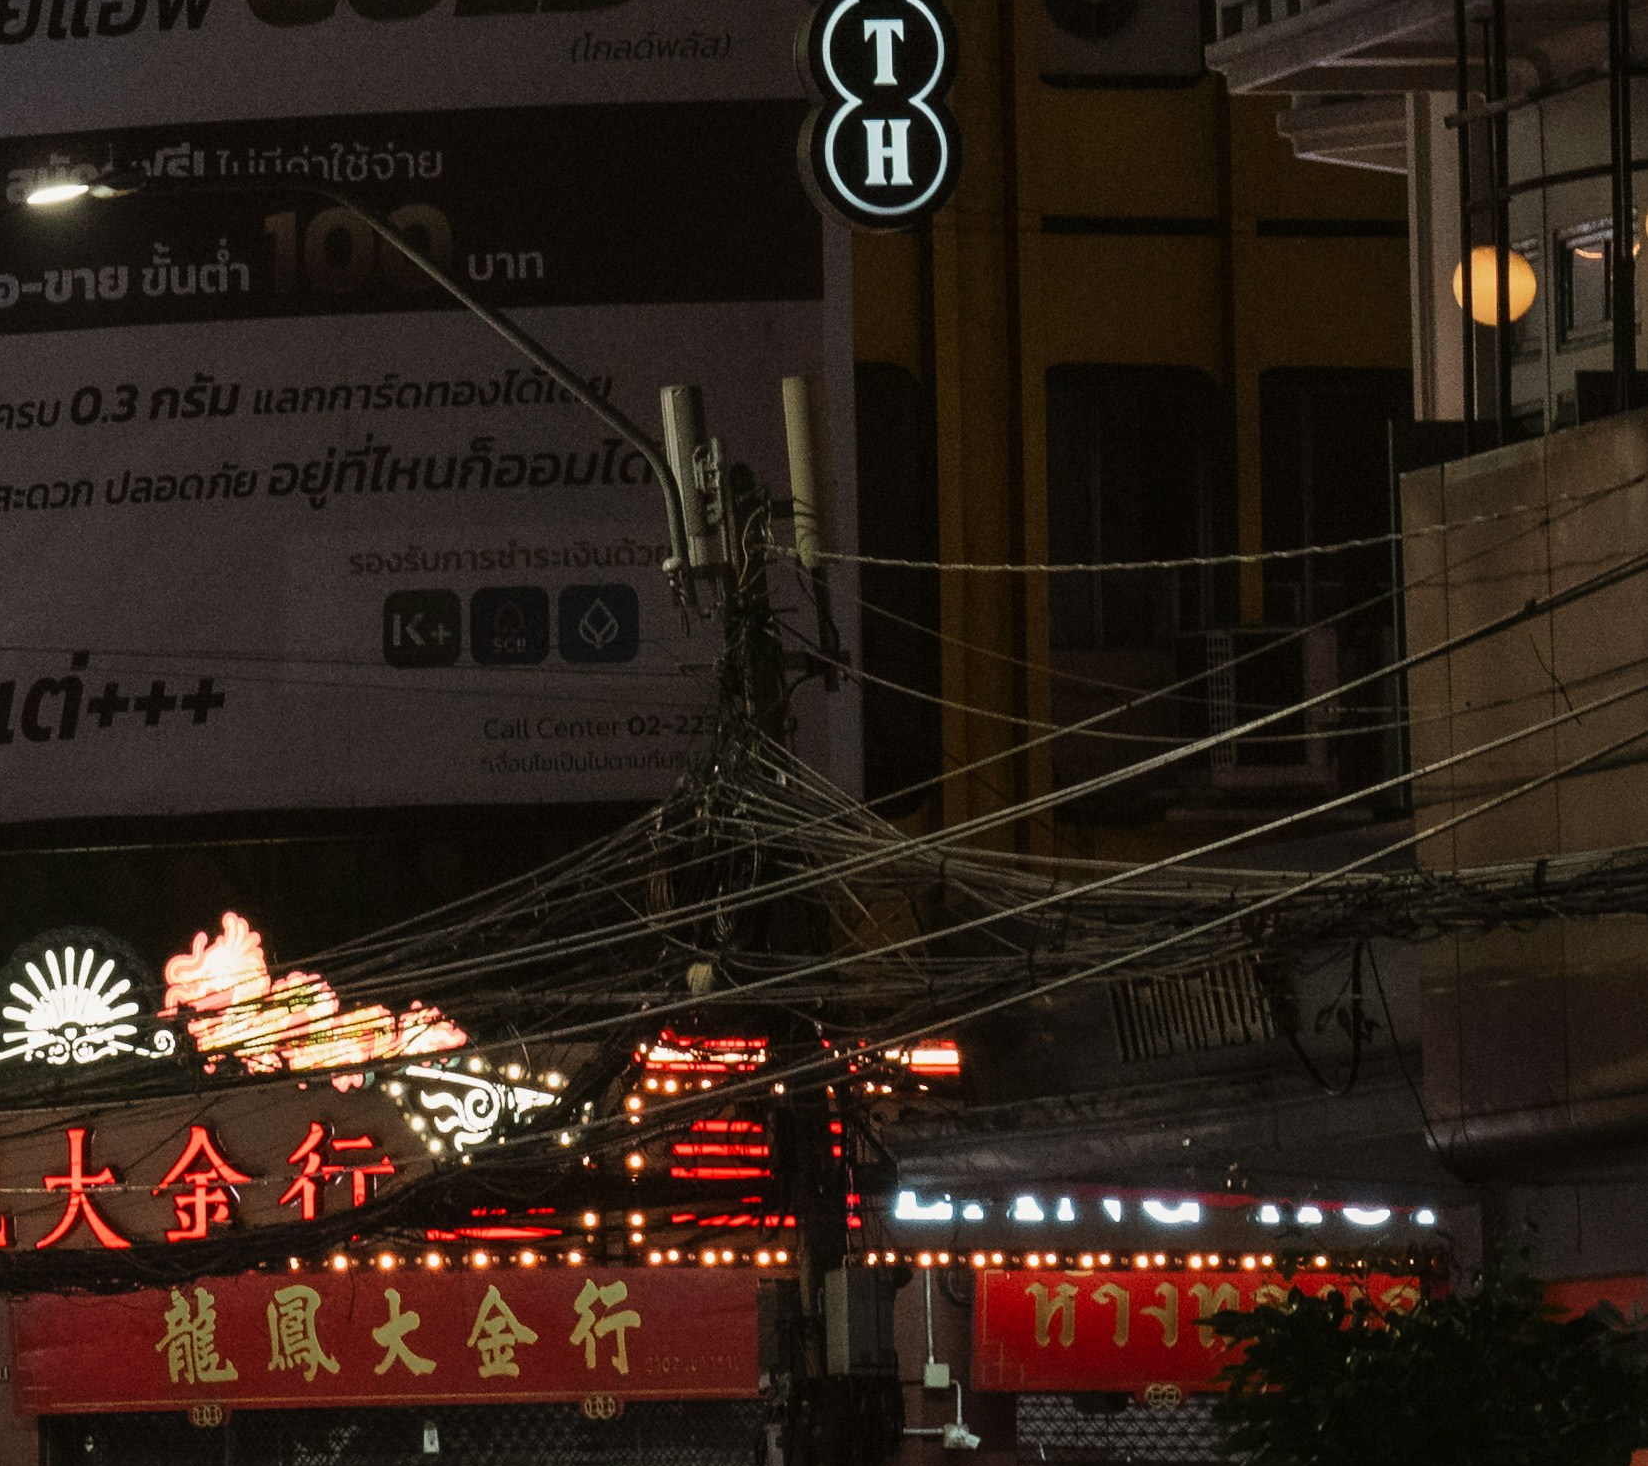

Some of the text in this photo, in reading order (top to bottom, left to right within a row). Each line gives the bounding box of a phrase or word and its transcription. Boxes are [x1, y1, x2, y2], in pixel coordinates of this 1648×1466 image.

[467, 248, 545, 282] บาท
[69, 387, 137, 425] 0.3
[155, 1280, 642, 1385] 龍鳳大金行
